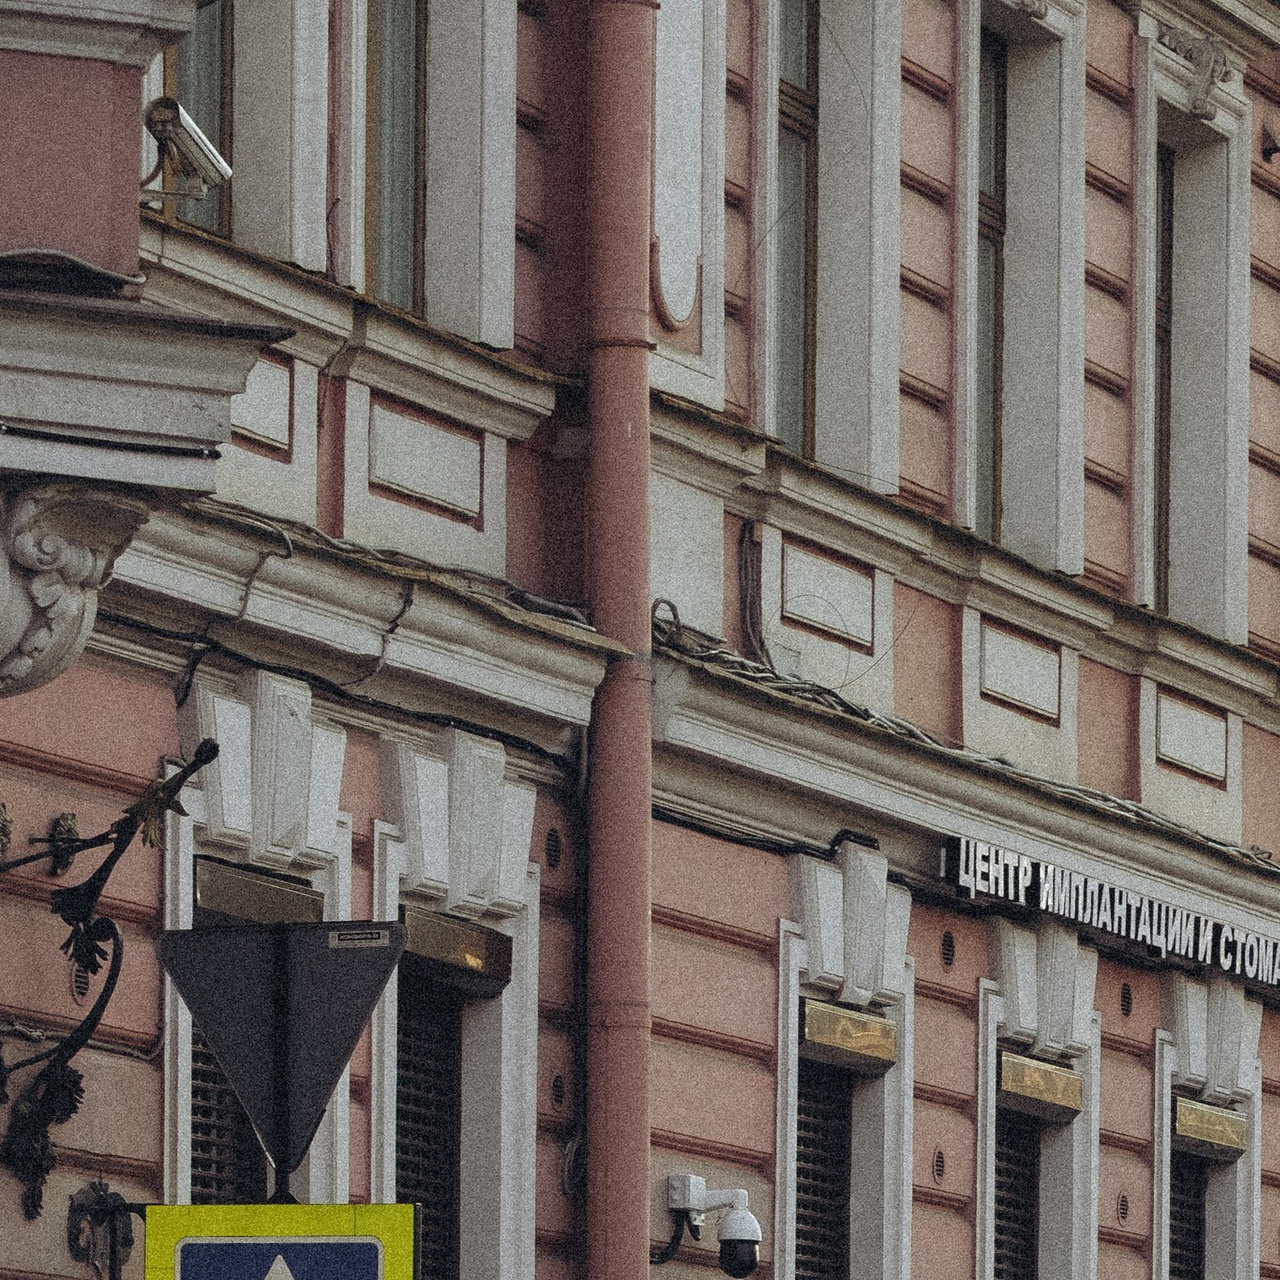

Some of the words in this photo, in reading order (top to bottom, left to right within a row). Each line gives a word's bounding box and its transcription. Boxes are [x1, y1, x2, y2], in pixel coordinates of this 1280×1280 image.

[959, 837, 1032, 905] ЦЕНТР
[1039, 862, 1195, 958] ИМПЛАНТАЦИИ
[1198, 916, 1213, 964] И
